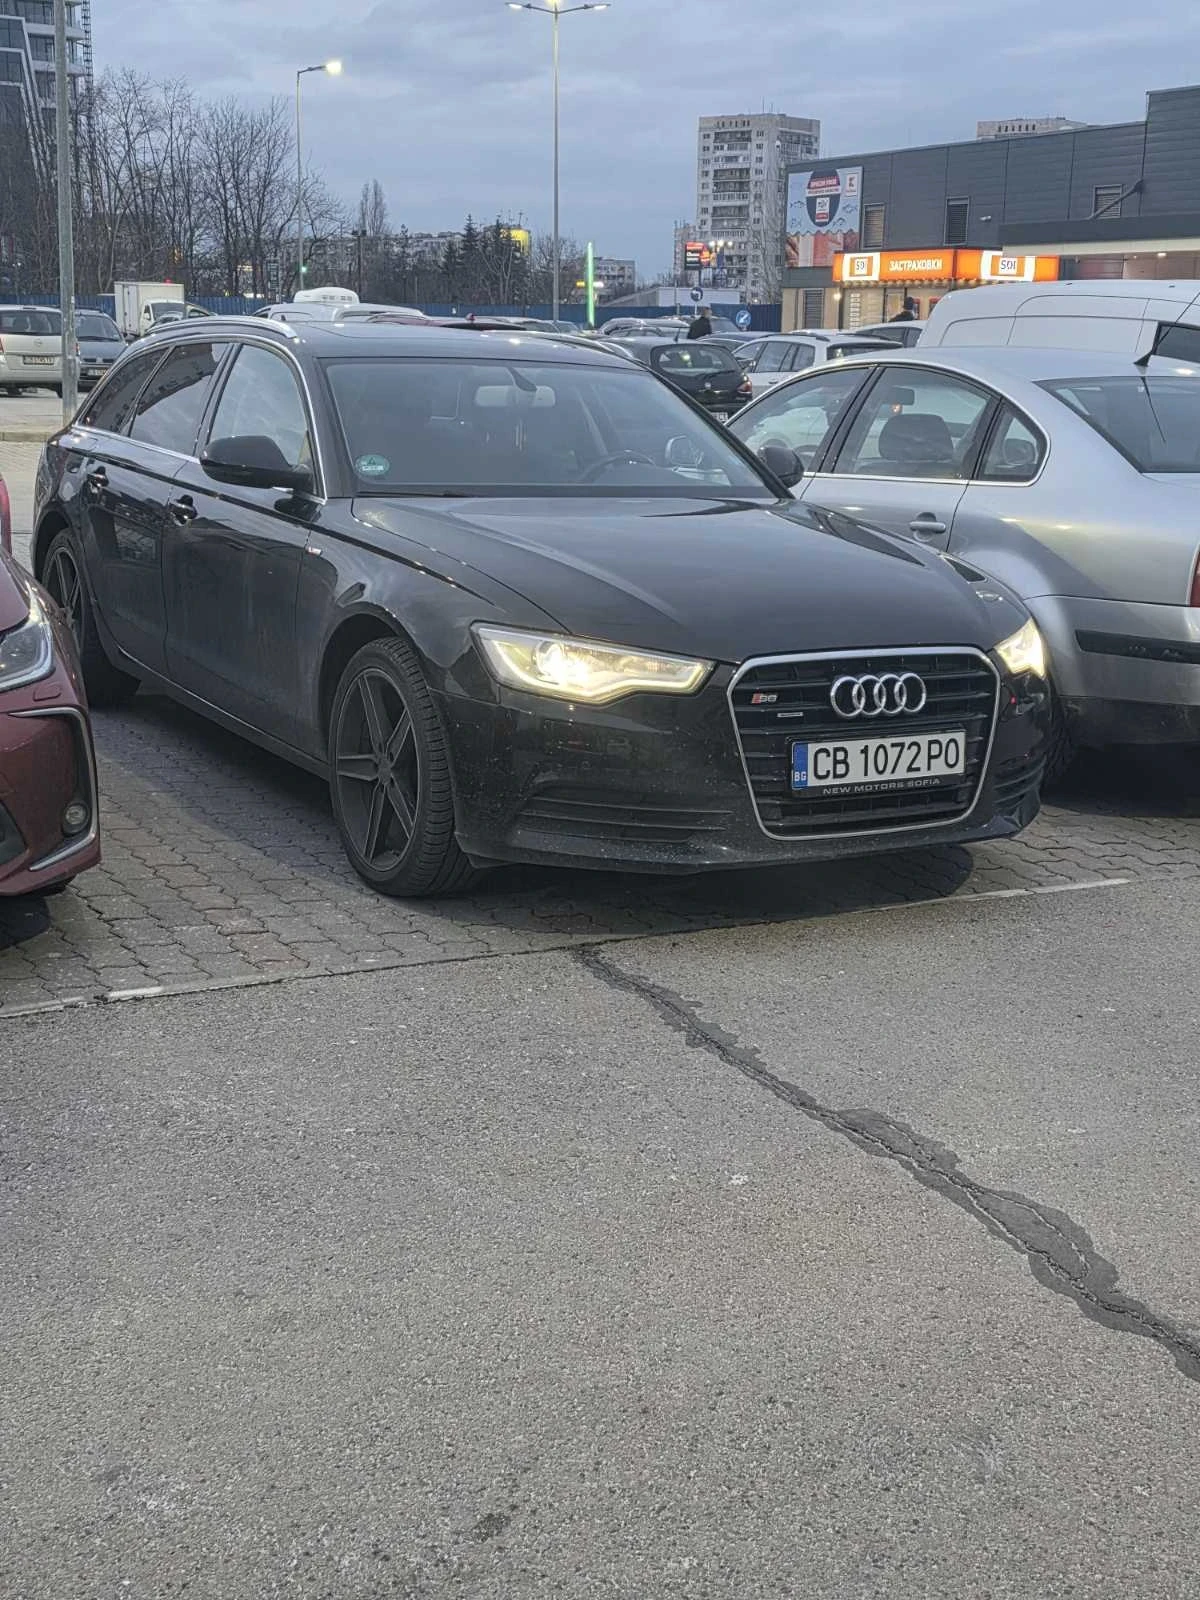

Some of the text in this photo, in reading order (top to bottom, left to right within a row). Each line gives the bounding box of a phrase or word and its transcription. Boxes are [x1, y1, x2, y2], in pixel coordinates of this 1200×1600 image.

[888, 258, 943, 272] ЗАСТРАХОВКИ
[813, 746, 849, 780] CB
[860, 741, 921, 777] 1072
[794, 771, 807, 782] BG
[822, 778, 941, 796] NEW MOTORS SOFIA
